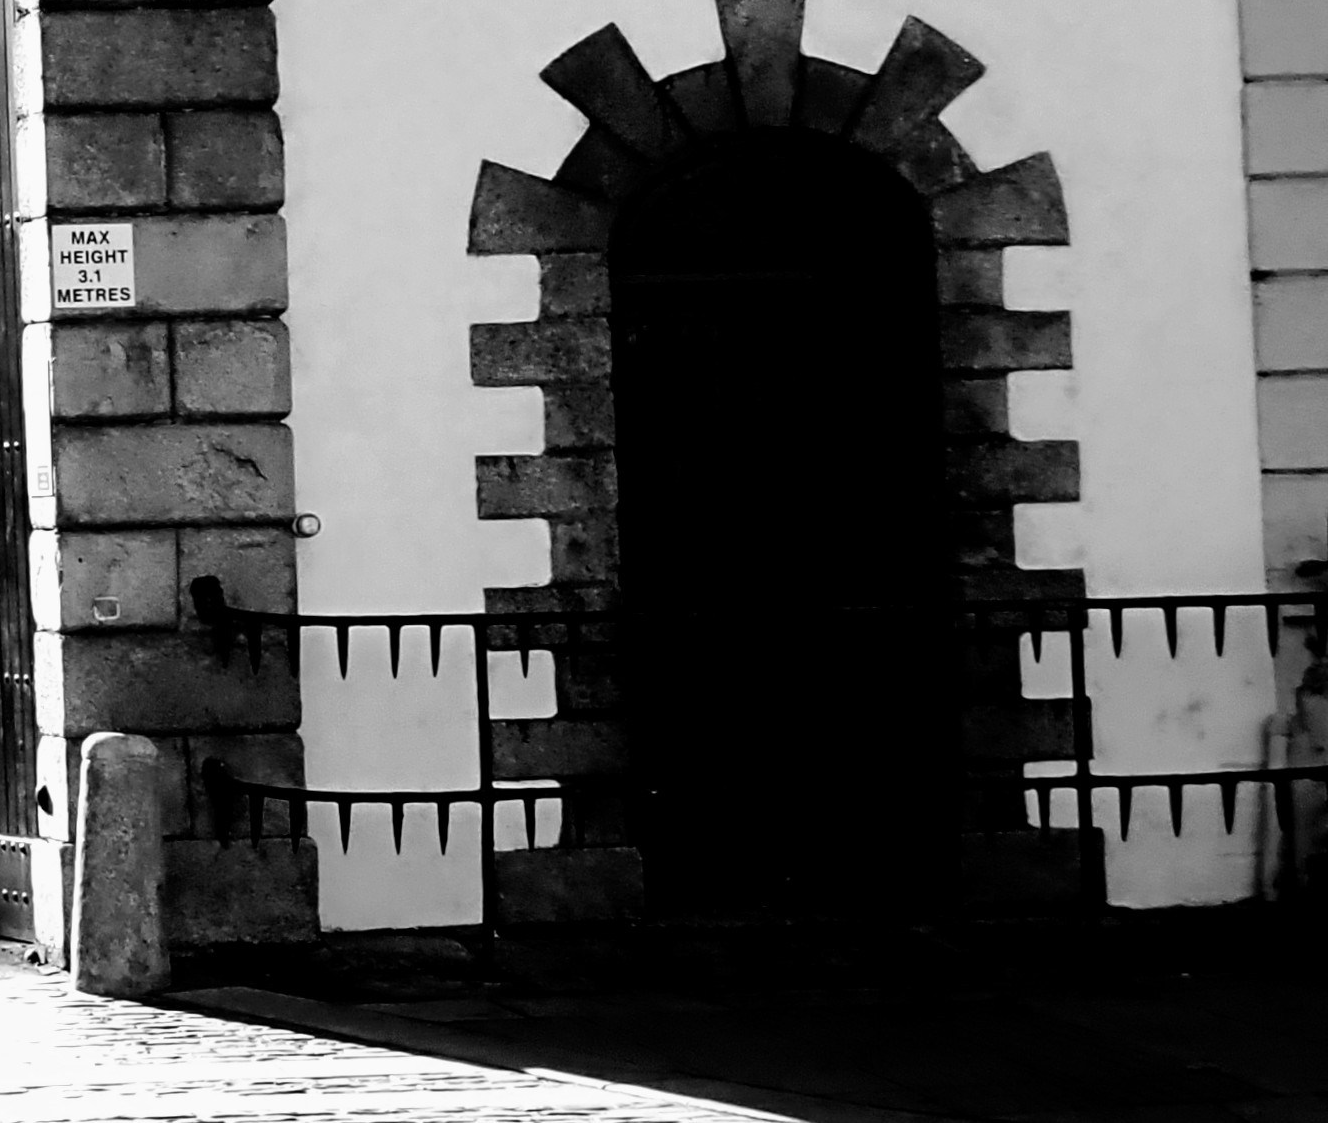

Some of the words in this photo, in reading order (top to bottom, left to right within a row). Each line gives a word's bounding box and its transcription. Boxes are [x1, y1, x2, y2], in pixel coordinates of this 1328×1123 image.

[71, 230, 110, 245] MAX
[60, 249, 128, 264] HEIGHT
[78, 269, 101, 283] 3.1
[57, 287, 132, 303] METRES
